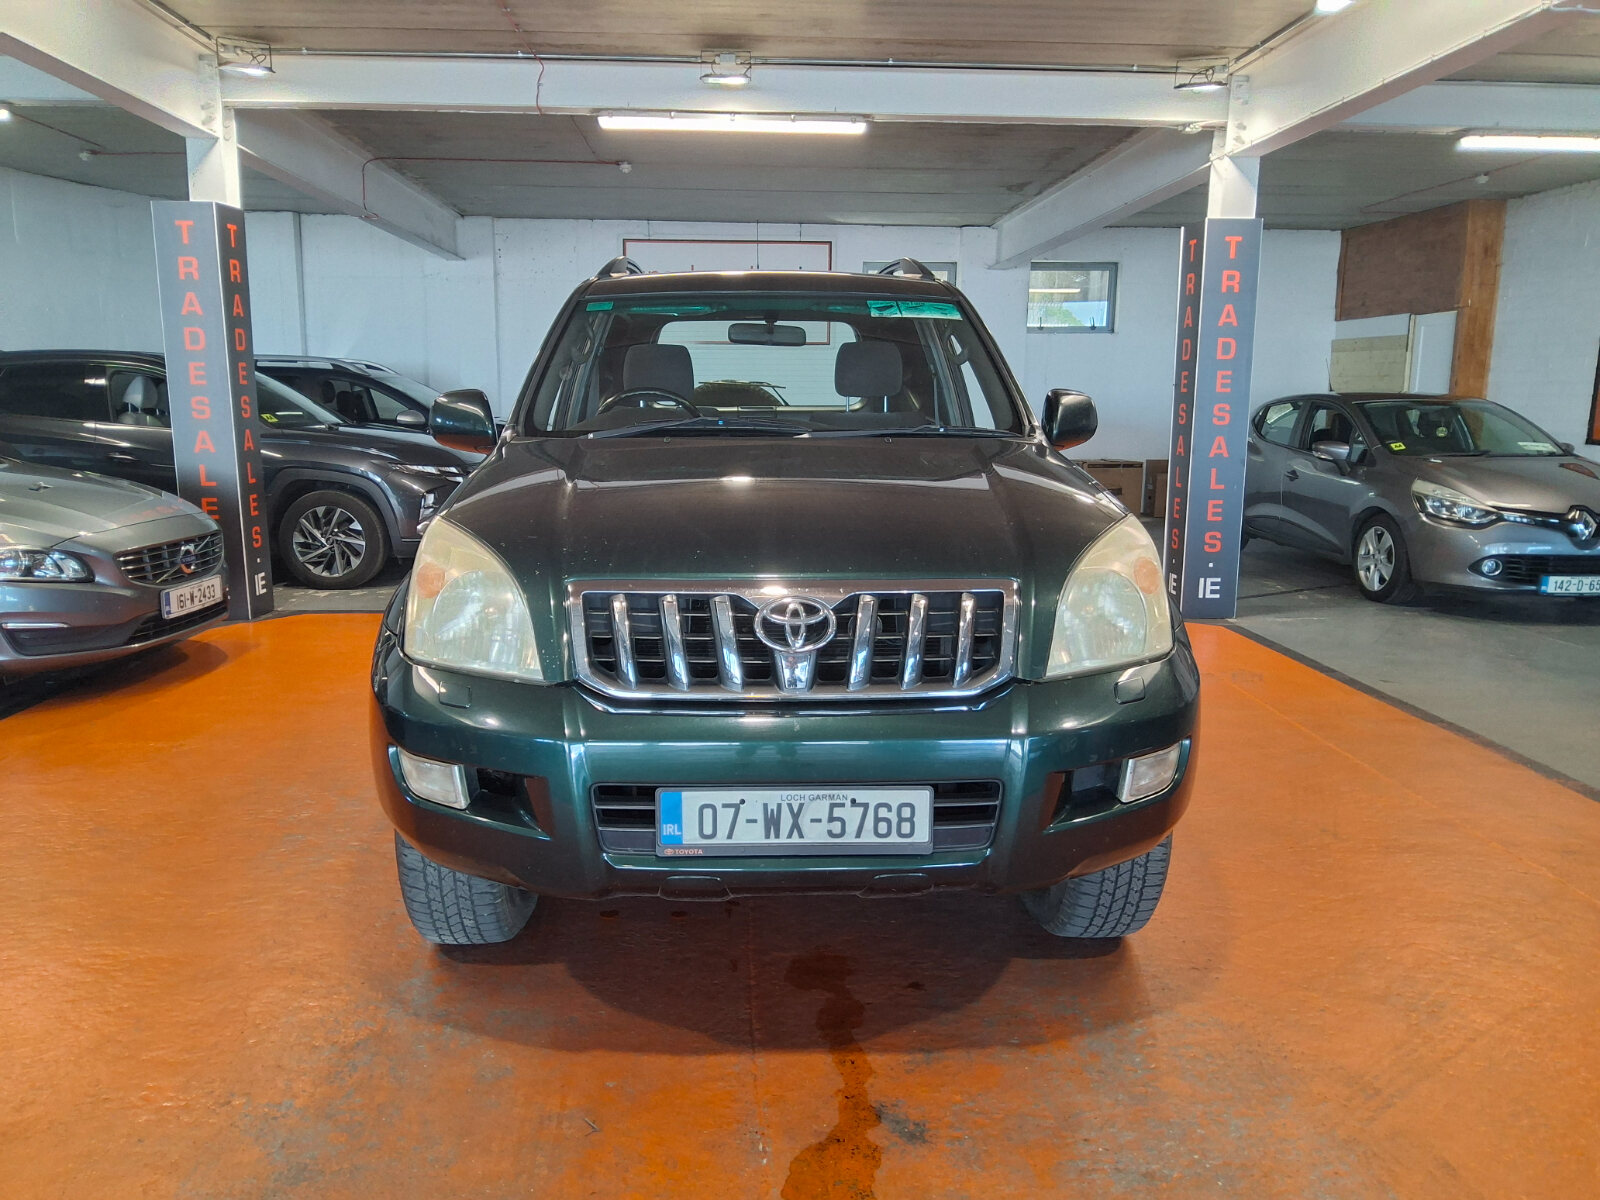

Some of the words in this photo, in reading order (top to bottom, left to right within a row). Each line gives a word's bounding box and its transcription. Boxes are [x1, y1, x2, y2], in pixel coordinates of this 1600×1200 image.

[176, 584, 216, 611] 161-W-2433
[780, 793, 806, 802] LOCH
[808, 793, 848, 802] GARMAN
[698, 802, 916, 840] 07-WX-5768
[663, 823, 682, 836] IRL
[674, 848, 704, 856] TOYOTA
